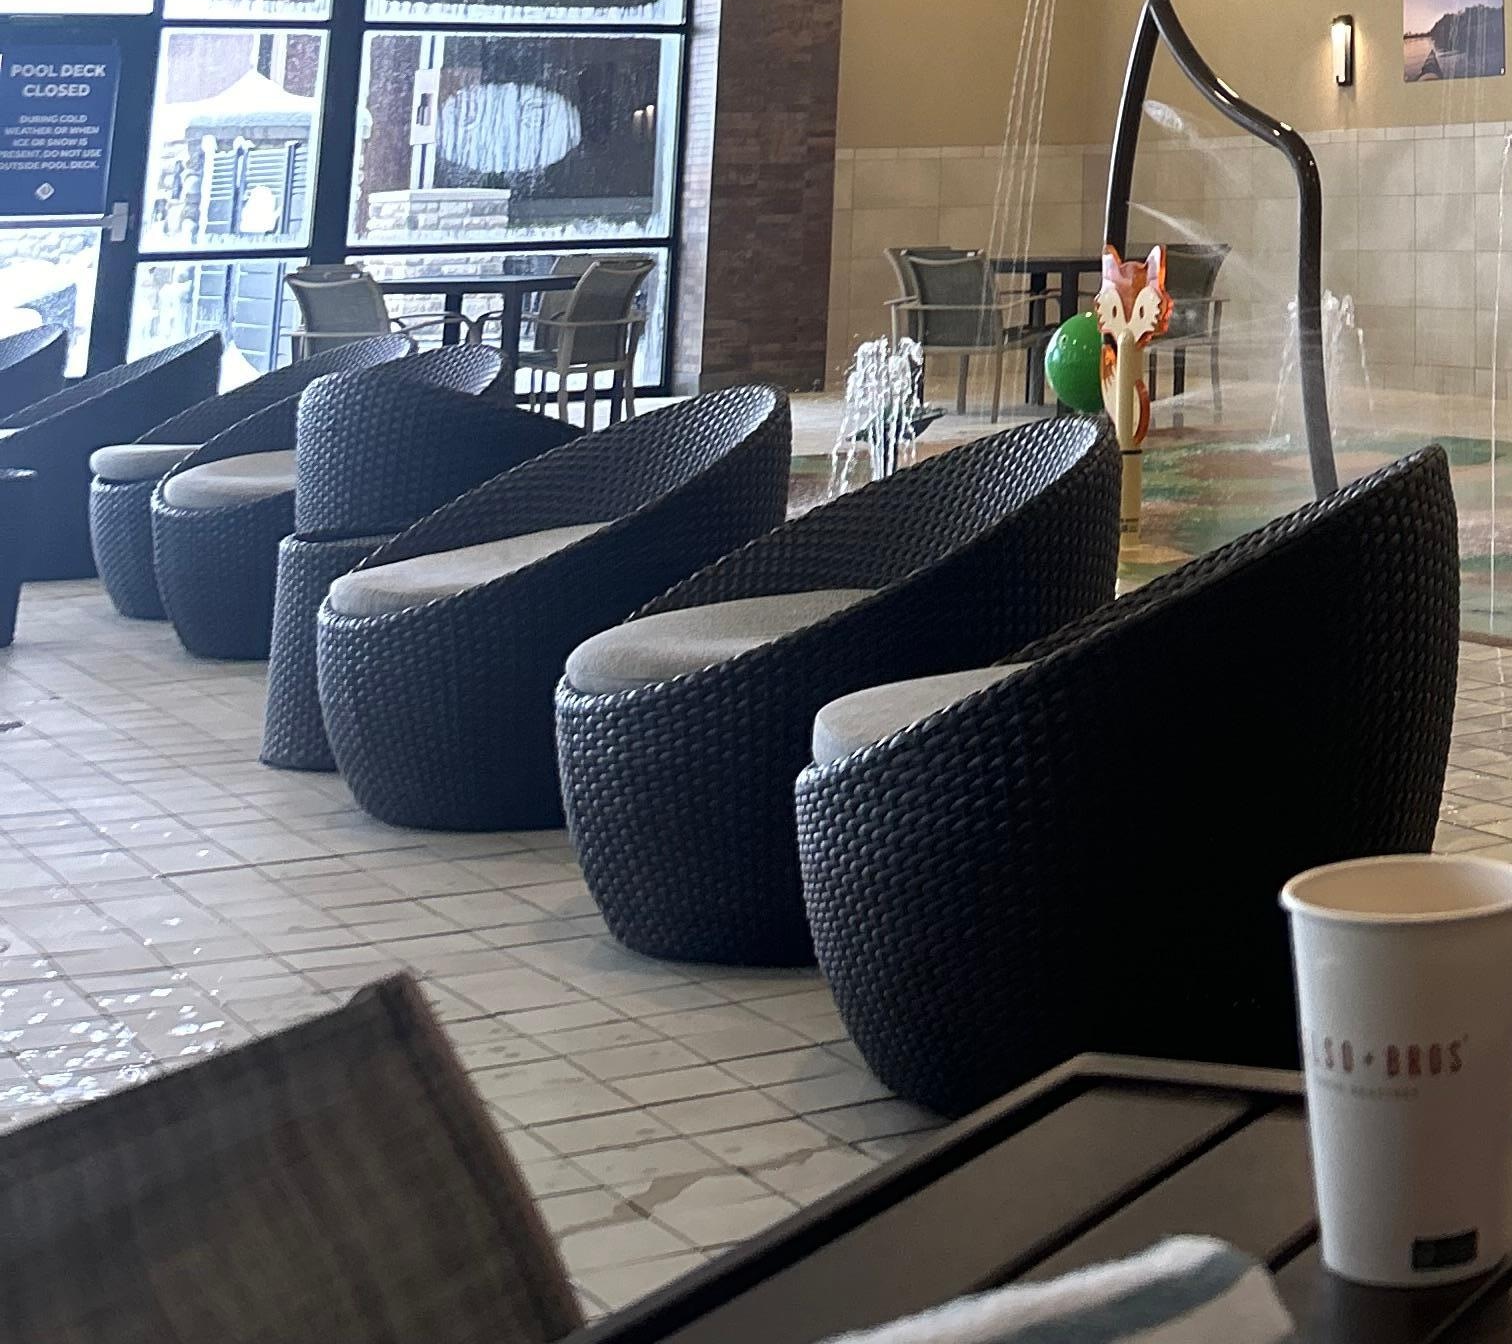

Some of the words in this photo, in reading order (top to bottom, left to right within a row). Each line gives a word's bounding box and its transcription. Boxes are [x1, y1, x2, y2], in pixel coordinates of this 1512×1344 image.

[10, 64, 58, 78] POOL
[60, 64, 106, 77] DECK
[22, 84, 91, 97] CLOSED
[19, 114, 58, 124] DURING
[59, 114, 88, 123] COLD
[4, 126, 53, 135] WEATHER
[54, 126, 68, 135] OR
[69, 125, 100, 134] WHEN
[13, 138, 30, 147] ICE
[31, 138, 45, 147] OR
[47, 137, 78, 146] SNOW
[79, 137, 88, 146] IS
[43, 149, 59, 158] DO
[60, 149, 82, 158] NOT
[82, 148, 102, 157] USE
[41, 161, 69, 169] POOL
